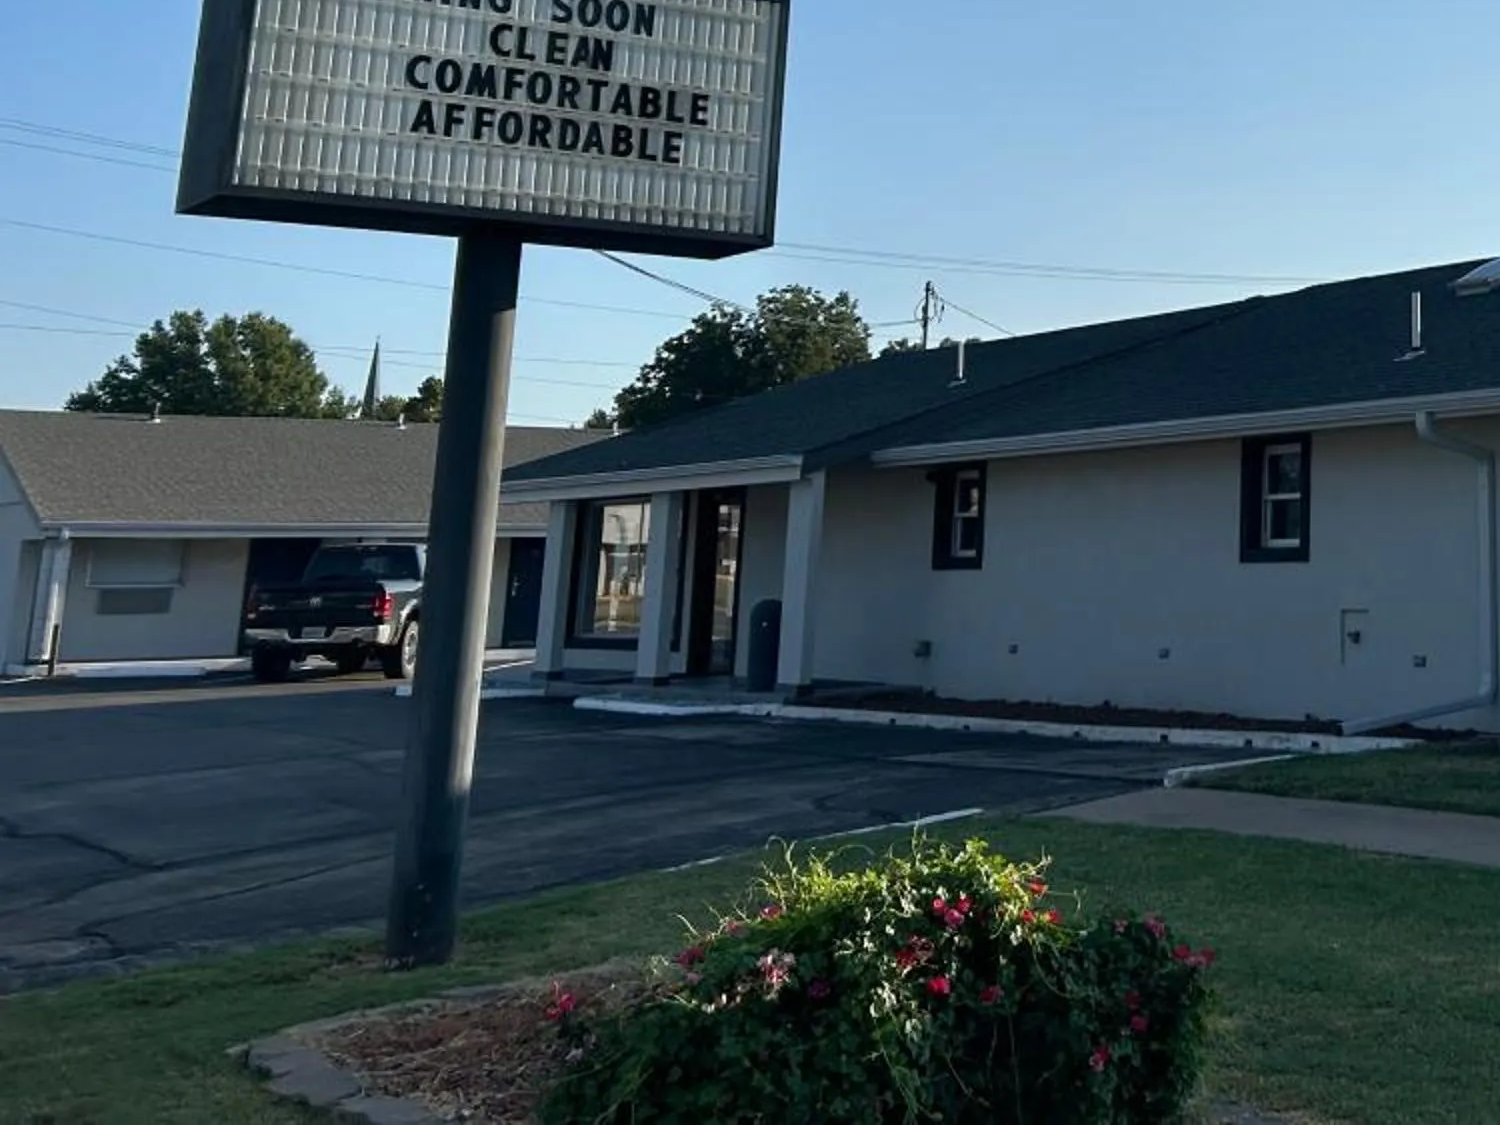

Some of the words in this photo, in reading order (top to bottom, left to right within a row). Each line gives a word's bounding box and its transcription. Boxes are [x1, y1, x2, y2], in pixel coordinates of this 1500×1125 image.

[490, 24, 614, 71] CLEAN
[406, 55, 709, 126] COMFORTABLE
[411, 101, 682, 163] AFFORDABLE
